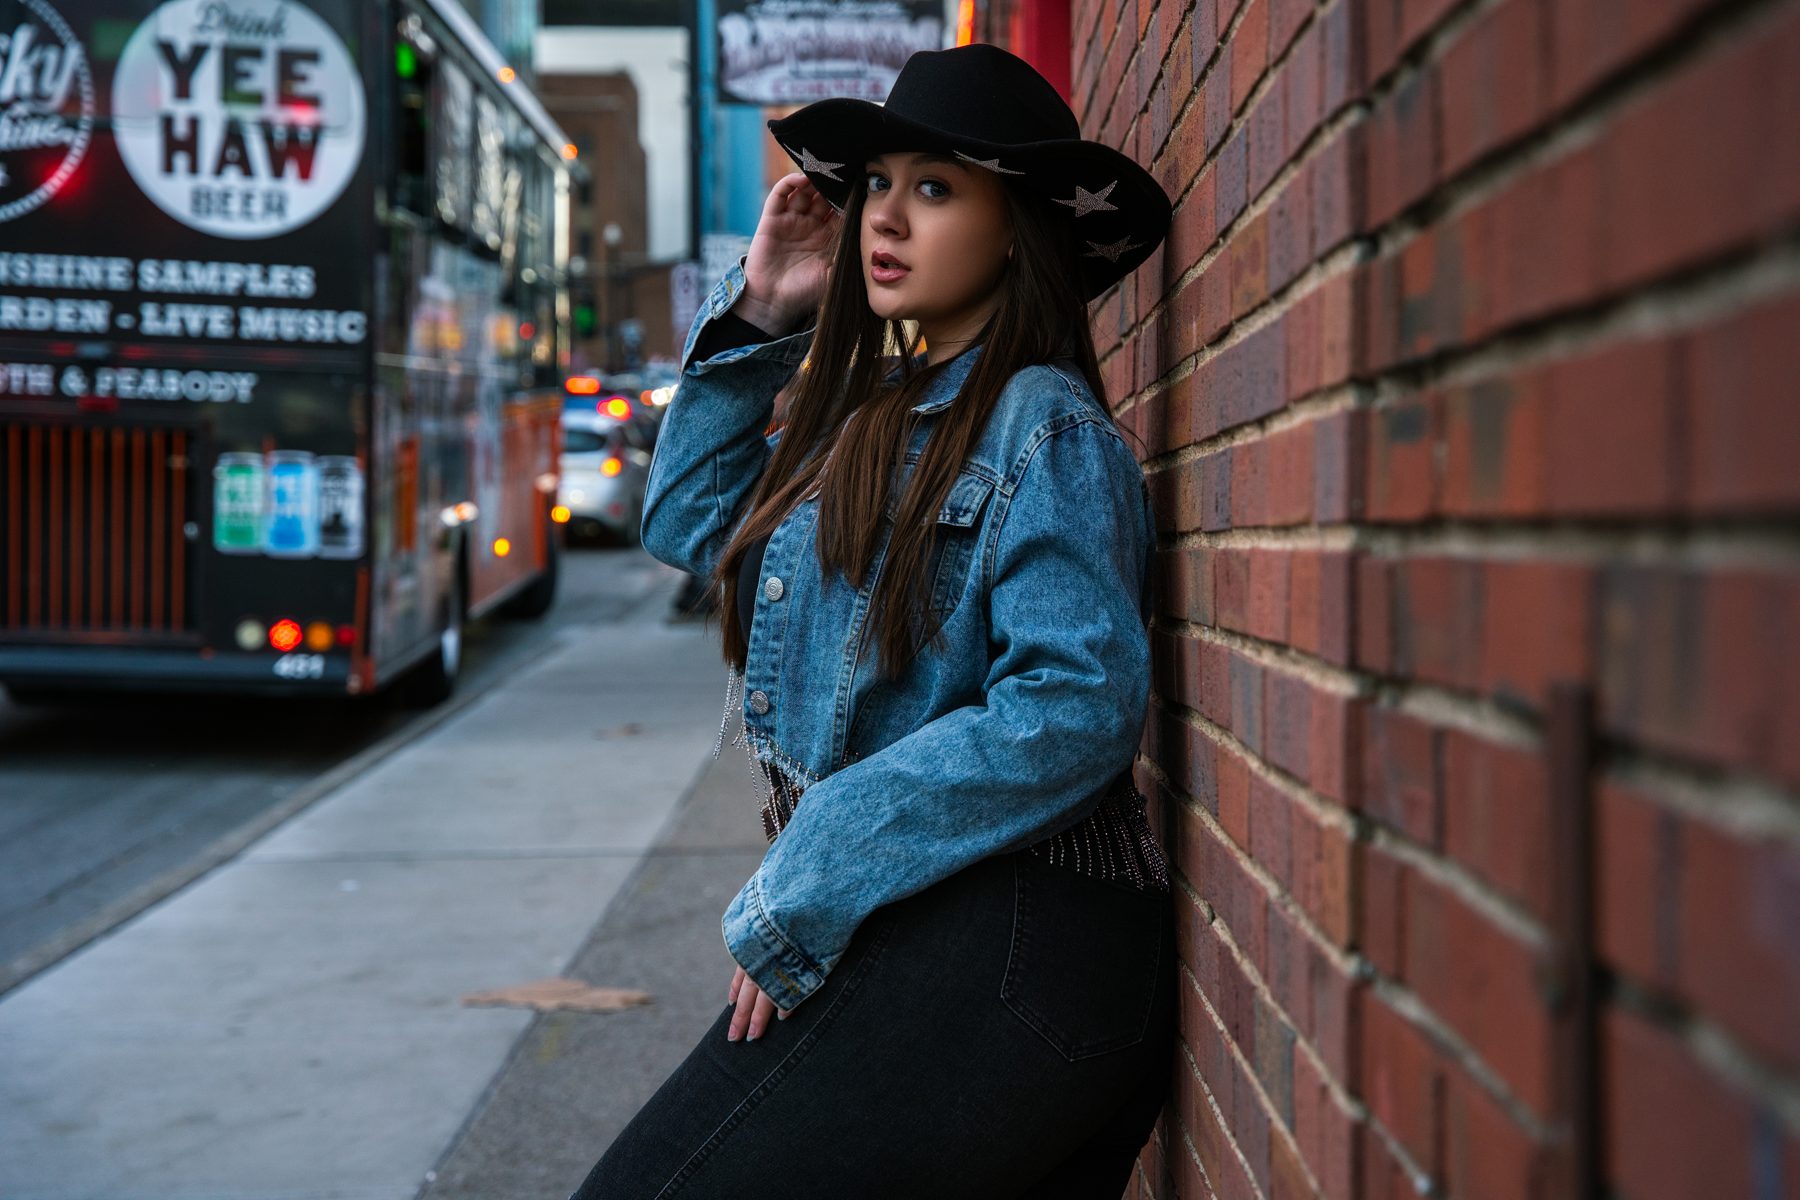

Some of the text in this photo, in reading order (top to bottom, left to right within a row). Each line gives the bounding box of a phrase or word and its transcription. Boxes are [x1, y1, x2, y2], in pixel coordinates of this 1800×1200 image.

[193, 2, 288, 34] Drink
[158, 42, 321, 107] YEE
[160, 114, 323, 182] HAW
[190, 185, 287, 219] BEER
[138, 258, 316, 299] SAMPLES
[139, 302, 235, 337] LIVE
[239, 307, 366, 344] MUSIC
[60, 365, 88, 397] &
[95, 367, 258, 402] PEABODY
